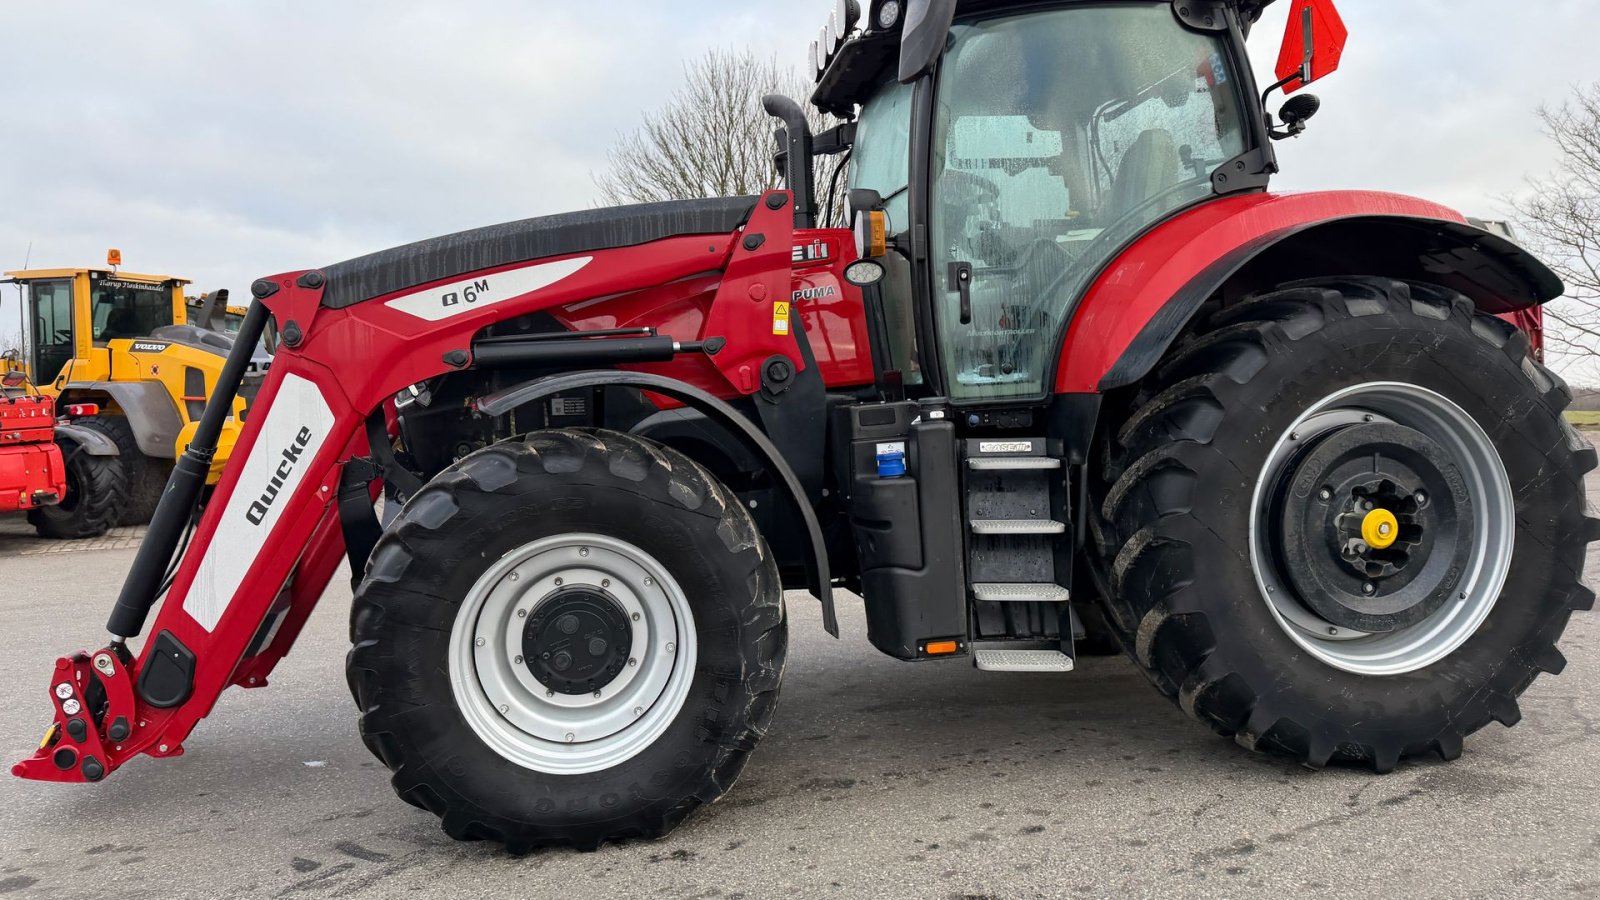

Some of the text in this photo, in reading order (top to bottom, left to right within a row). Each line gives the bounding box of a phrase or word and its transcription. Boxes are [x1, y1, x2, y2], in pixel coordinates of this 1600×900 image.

[792, 286, 835, 302] PUMA
[134, 343, 166, 351] VOLVO
[245, 425, 312, 526] Quicke
